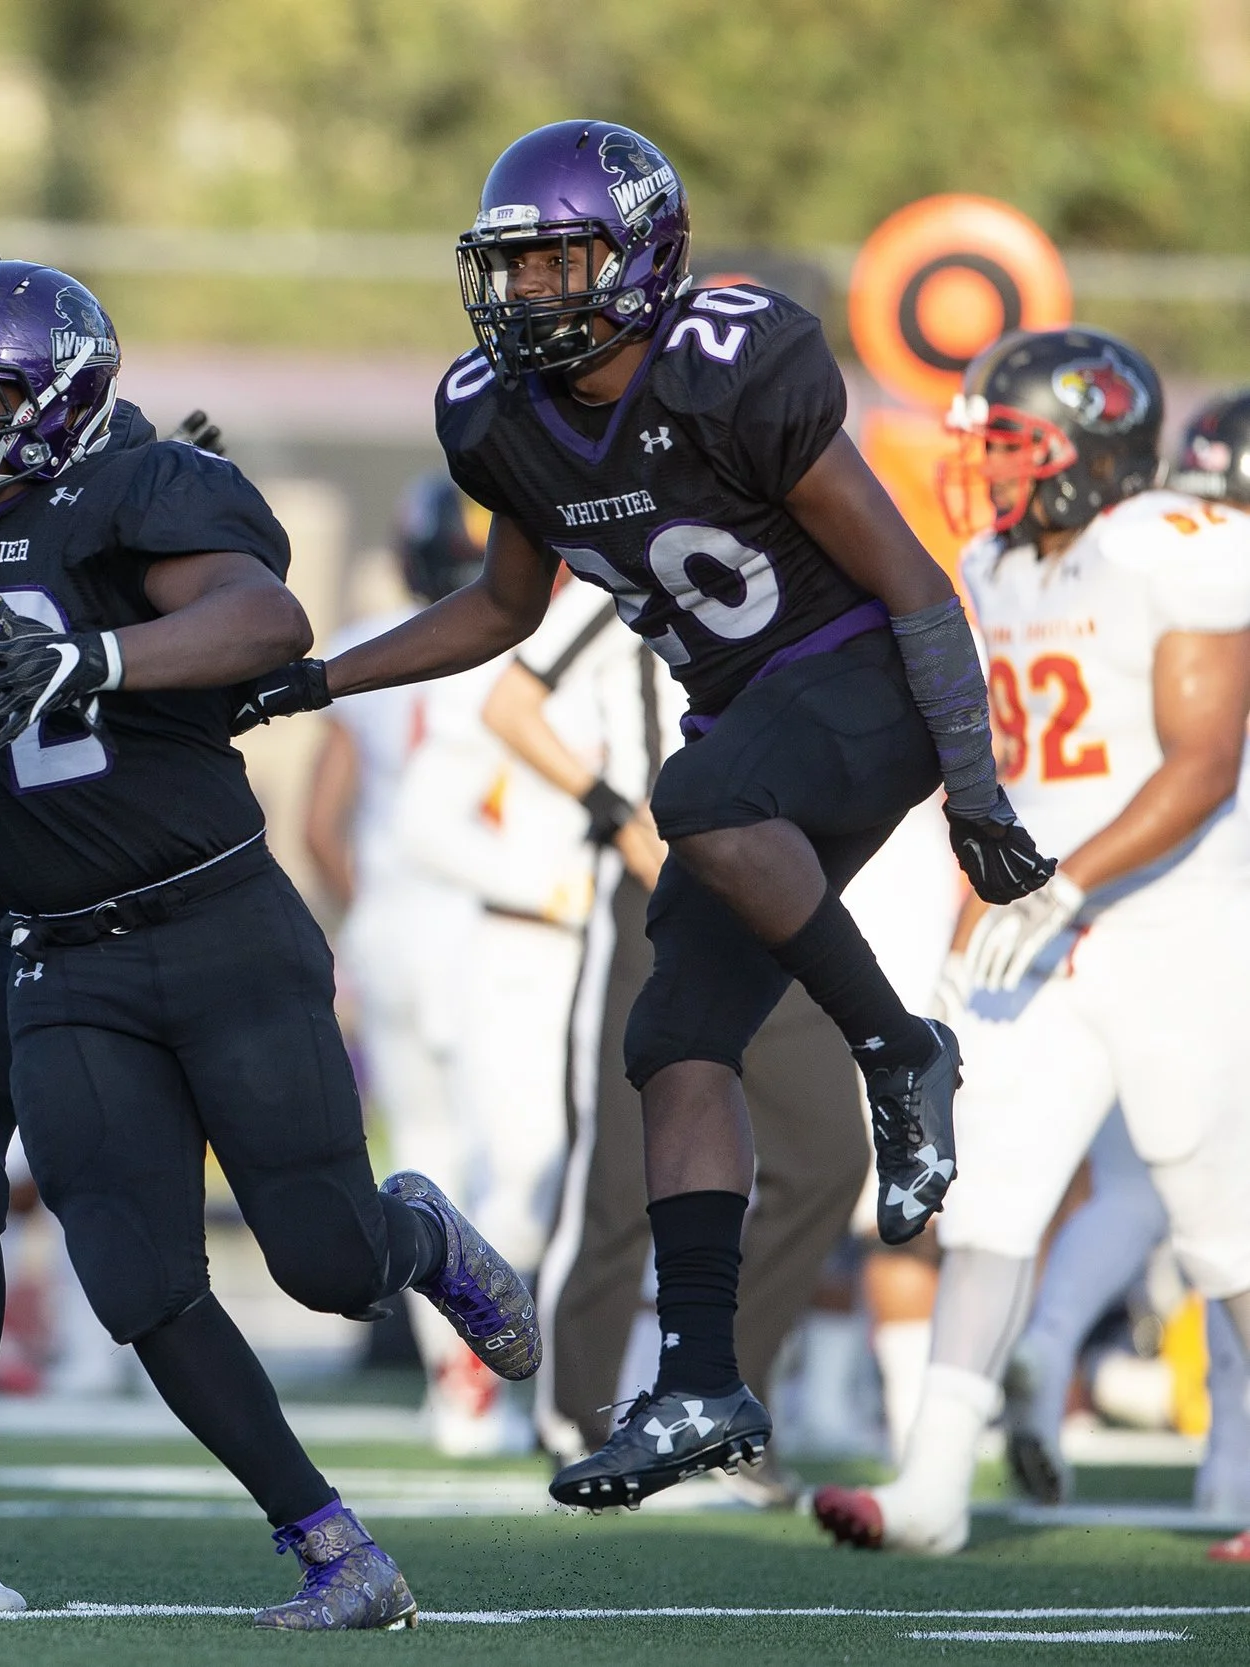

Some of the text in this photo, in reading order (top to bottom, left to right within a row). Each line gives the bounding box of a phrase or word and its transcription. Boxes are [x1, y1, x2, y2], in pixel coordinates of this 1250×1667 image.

[665, 287, 770, 361] 20
[556, 490, 657, 527] WHITTIER
[989, 653, 1110, 783] 92
